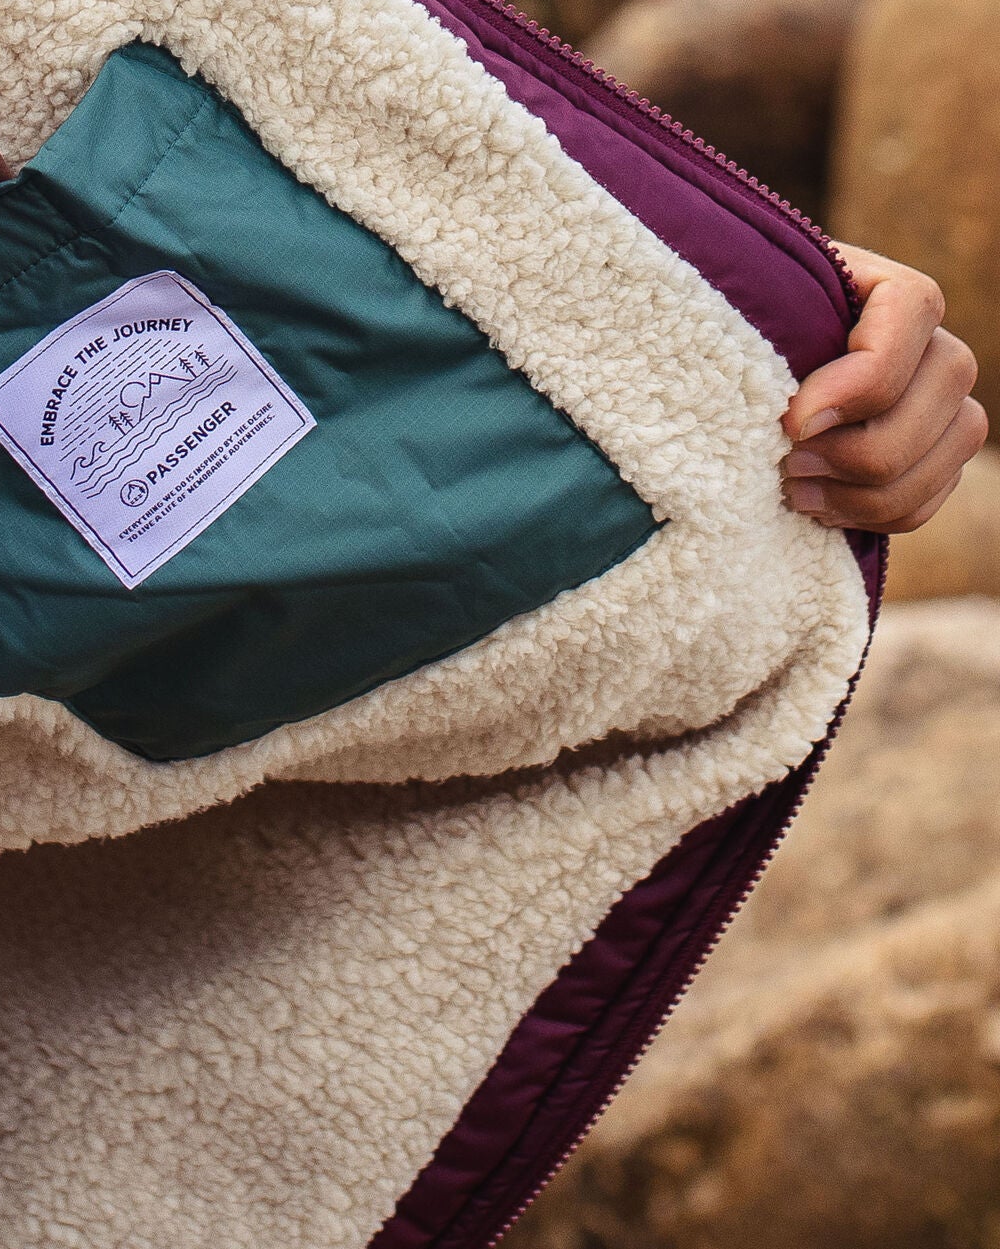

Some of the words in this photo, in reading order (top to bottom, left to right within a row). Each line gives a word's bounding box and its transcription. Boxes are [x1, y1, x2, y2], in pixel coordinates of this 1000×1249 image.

[40, 365, 78, 446] EMBRACE
[74, 336, 108, 364] THE
[113, 318, 194, 342] JOURNEY
[146, 401, 237, 485] PASSENGER
[119, 501, 164, 539] EVERYTHING
[162, 490, 176, 502] WE
[175, 480, 187, 492] DO
[185, 473, 195, 483] IS
[193, 446, 224, 476] INSPIRED
[223, 435, 234, 447] BY
[233, 423, 249, 437] THE
[247, 401, 273, 425] DESIRE
[127, 533, 138, 543] TO
[137, 520, 155, 535] LIVE
[154, 514, 162, 523] A
[161, 500, 177, 516] LIFE
[177, 492, 187, 503] OF
[186, 453, 230, 494] MEMORABLE
[228, 414, 276, 456] ADVENTURES.
